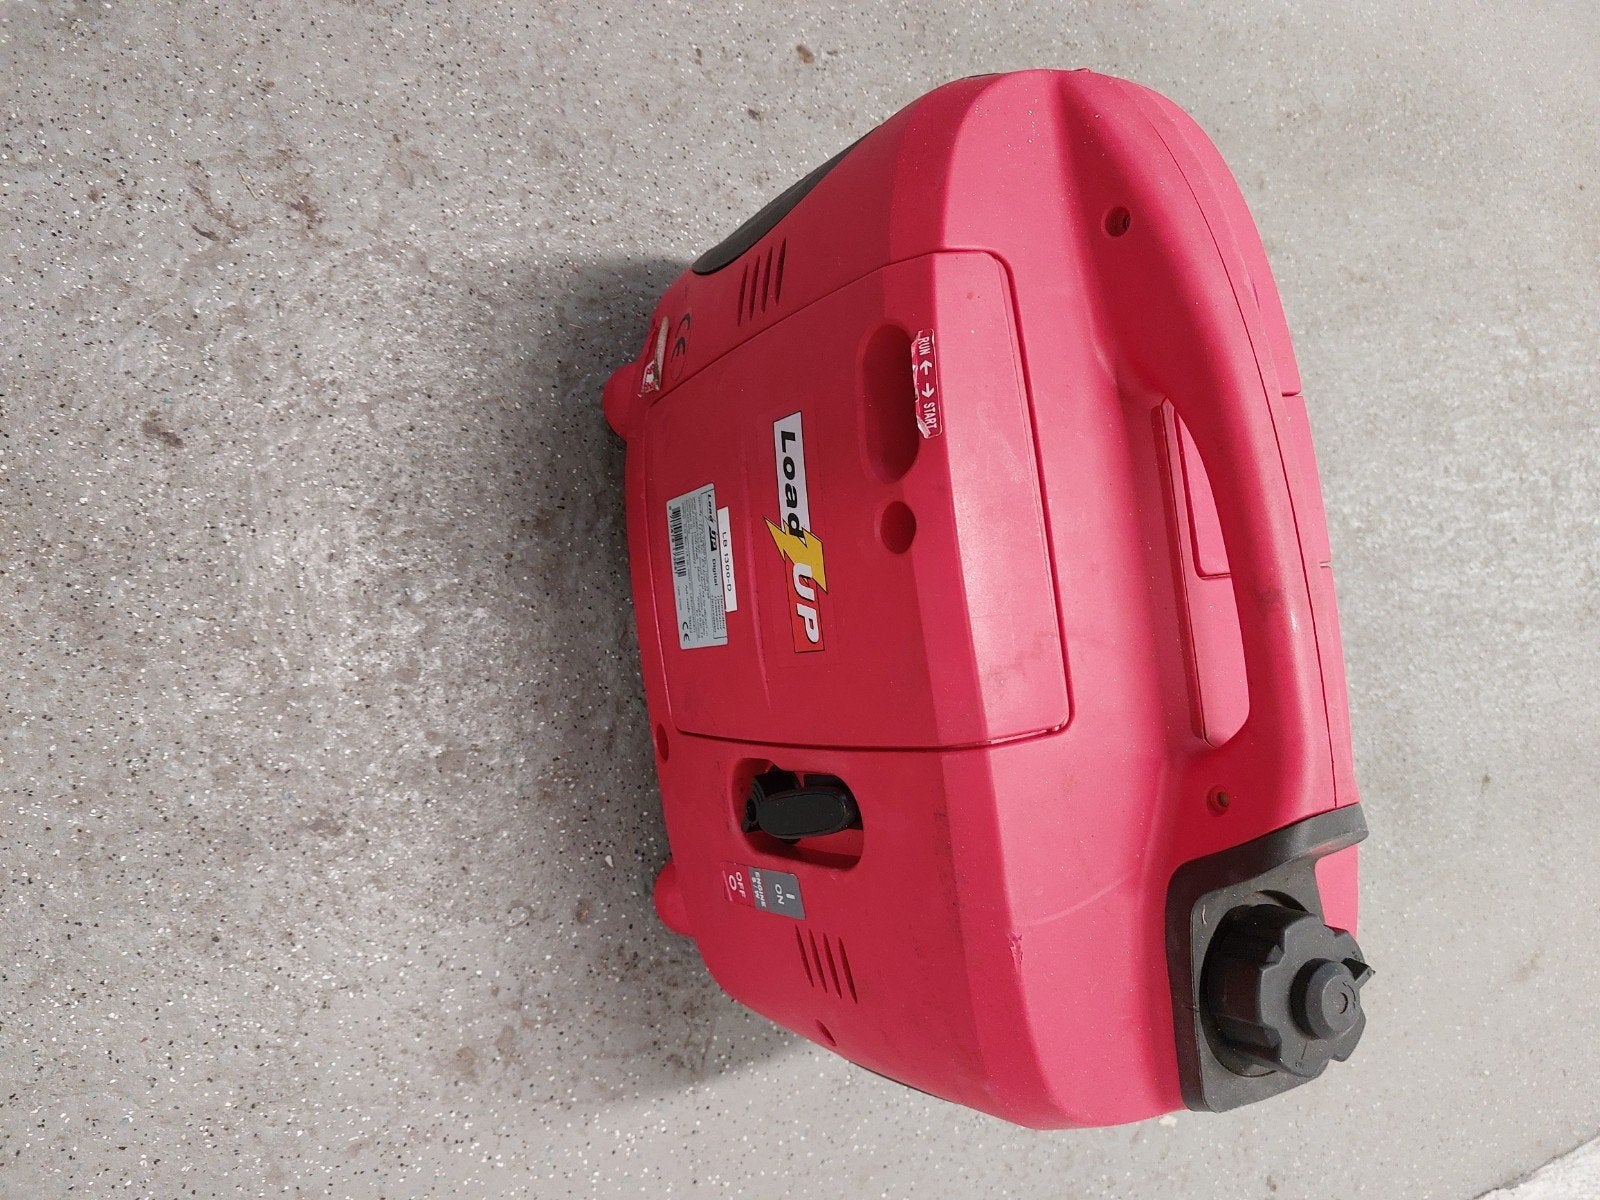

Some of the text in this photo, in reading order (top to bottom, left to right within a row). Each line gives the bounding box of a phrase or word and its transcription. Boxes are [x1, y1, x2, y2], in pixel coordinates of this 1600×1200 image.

[918, 336, 938, 429] RUN START
[780, 430, 820, 643] Load UP
[723, 552, 732, 592] 1300-D
[735, 871, 746, 898] OFF
[755, 871, 767, 908] ENGINE
[775, 884, 785, 905] ON
